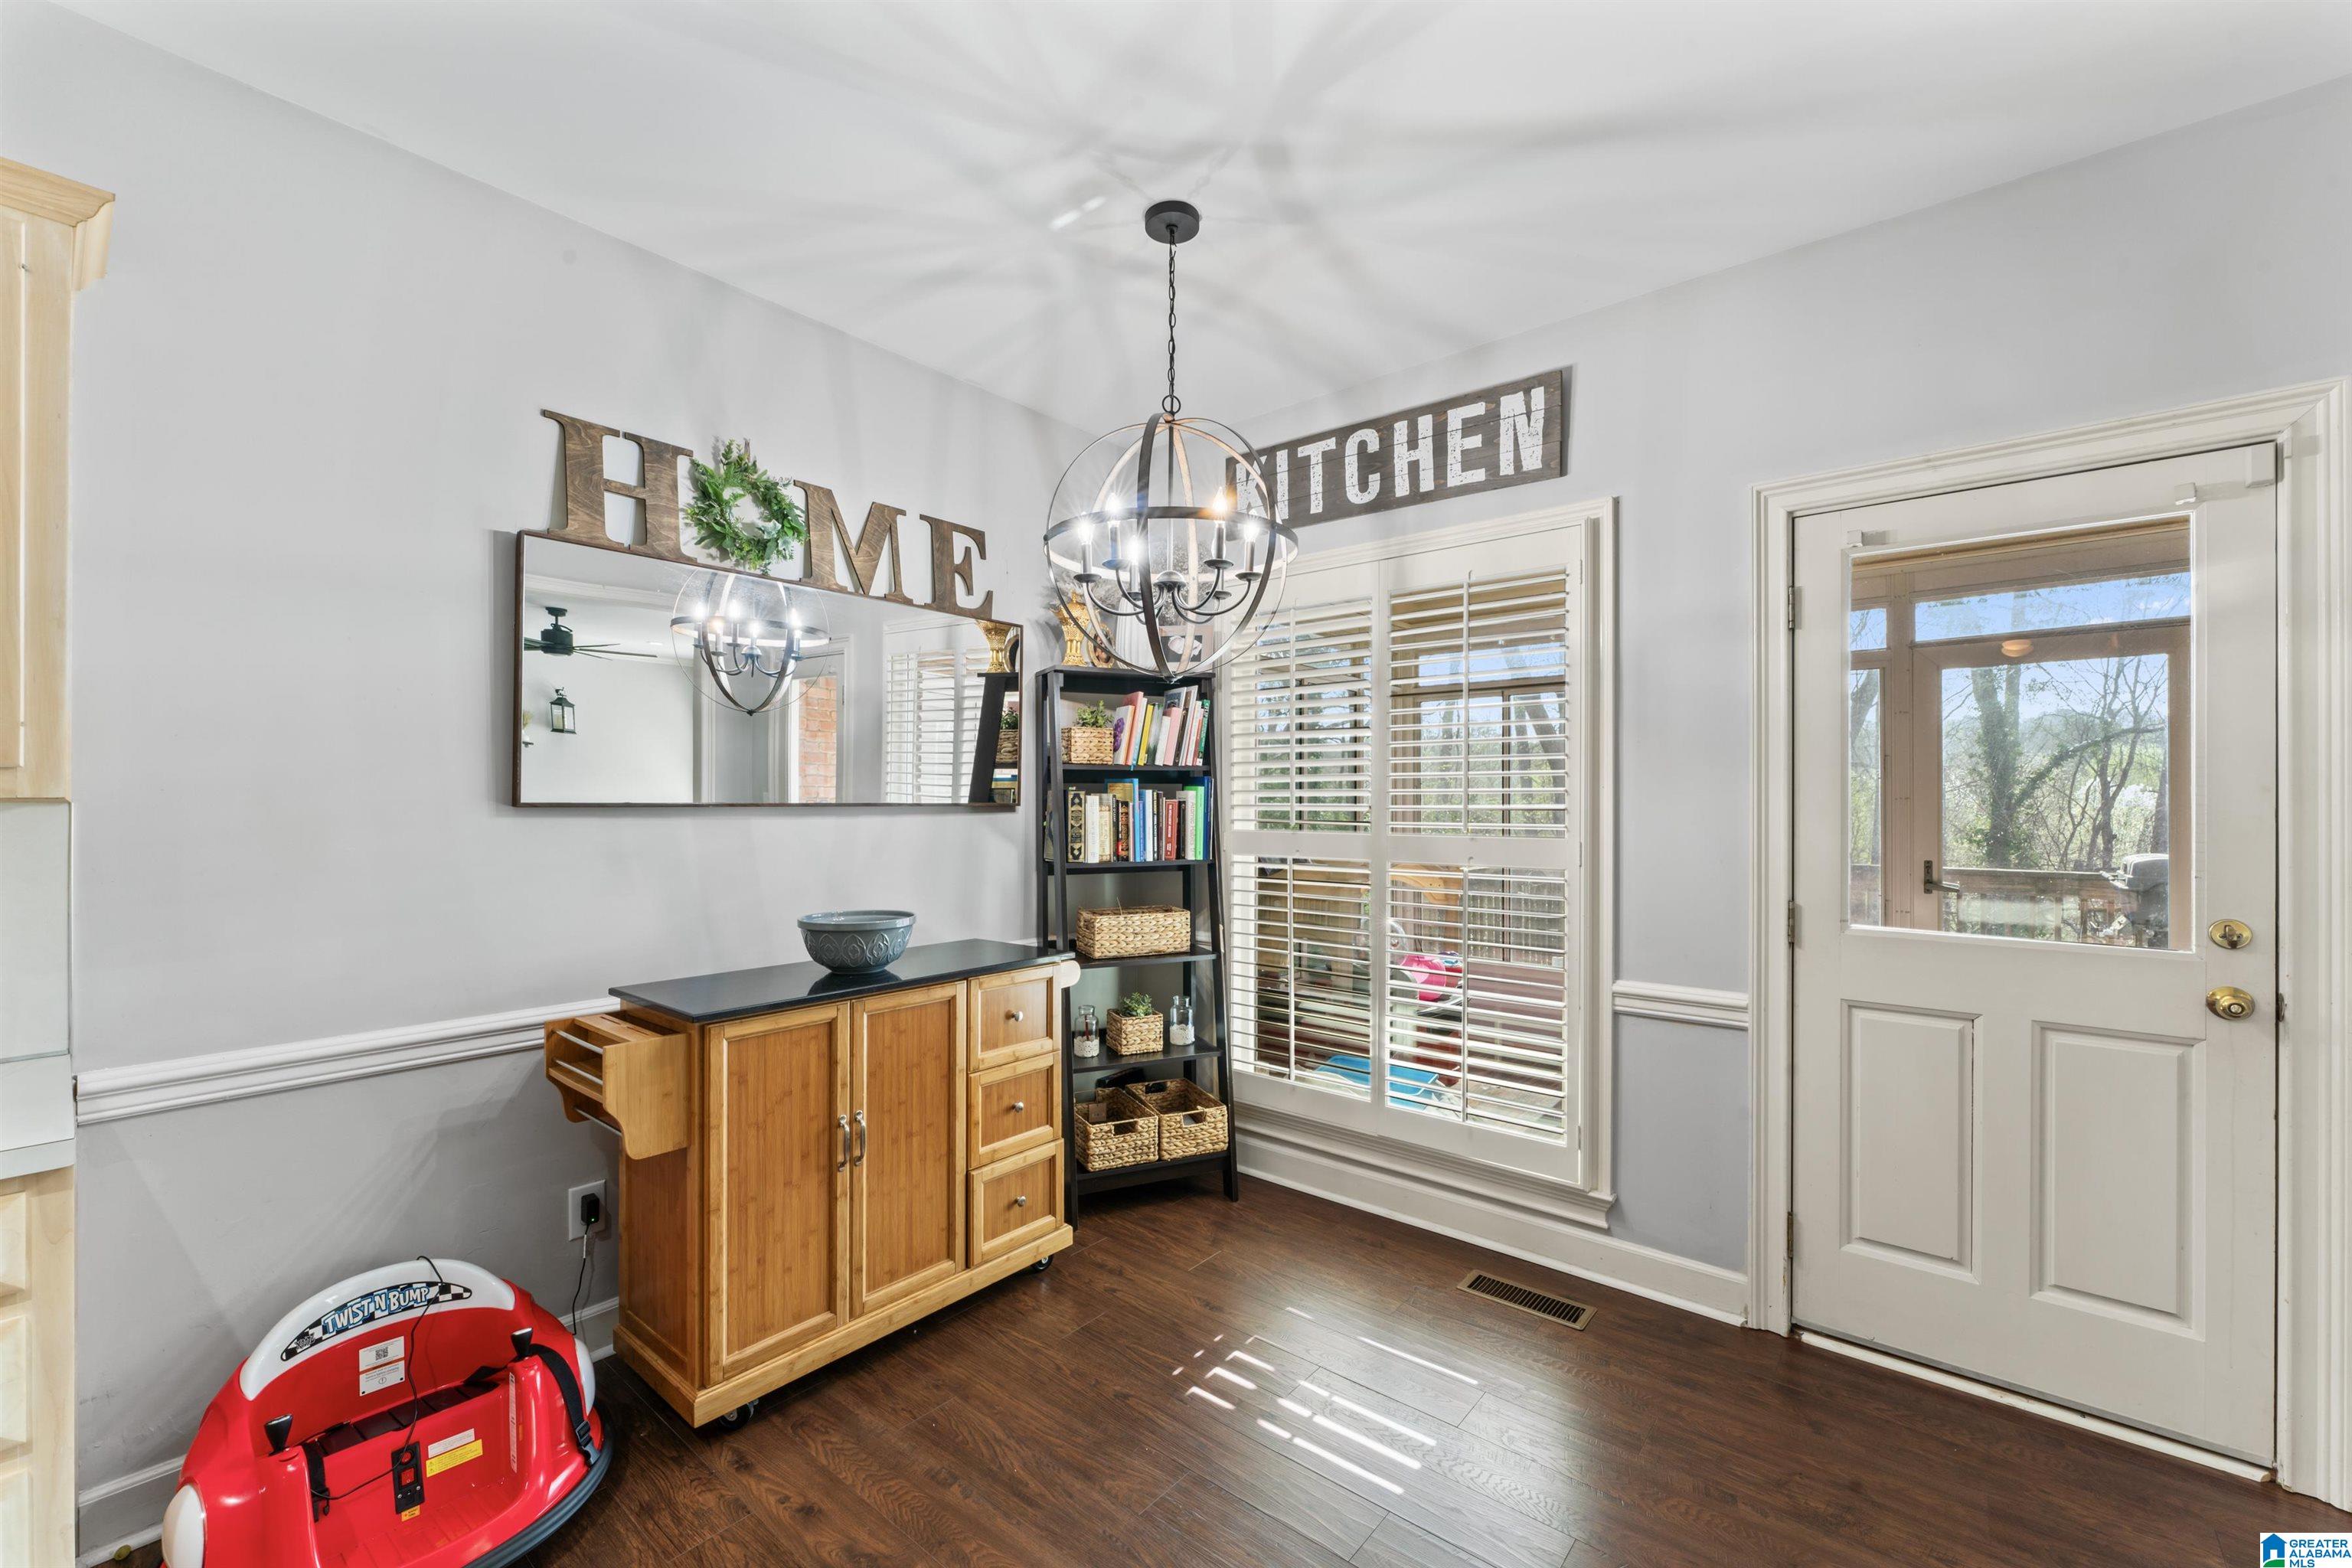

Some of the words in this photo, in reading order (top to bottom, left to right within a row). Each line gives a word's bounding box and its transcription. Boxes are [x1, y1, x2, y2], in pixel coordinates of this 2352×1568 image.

[1235, 386, 1545, 521] KITCHEN
[324, 1298, 372, 1333] TWIST
[374, 1293, 387, 1310] N
[388, 1287, 429, 1311] BUMP
